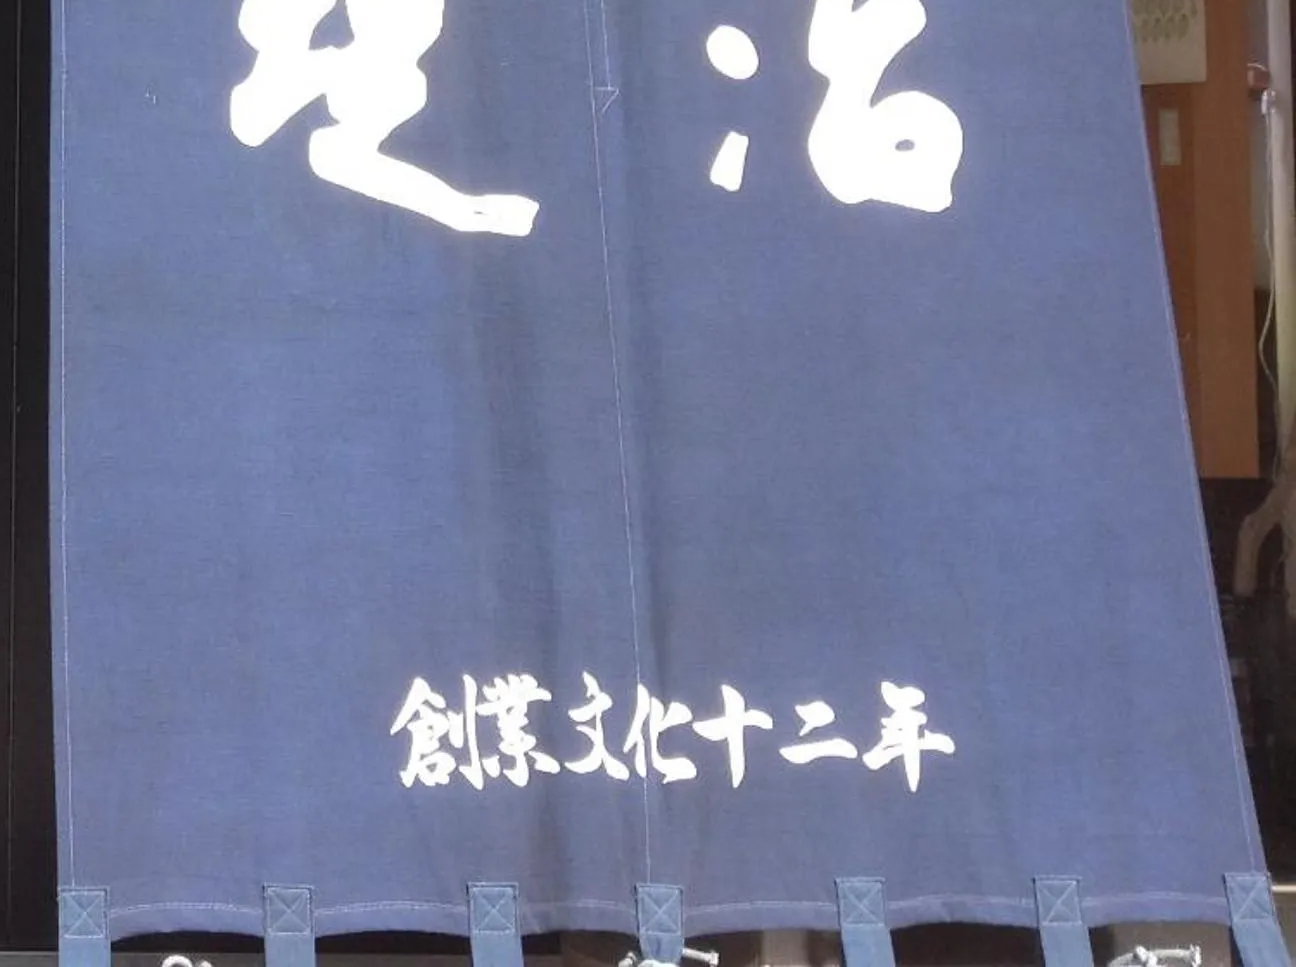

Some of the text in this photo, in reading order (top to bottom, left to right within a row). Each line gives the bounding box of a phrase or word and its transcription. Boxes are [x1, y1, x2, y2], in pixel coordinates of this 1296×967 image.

[391, 672, 956, 792] 創業文化十二年
